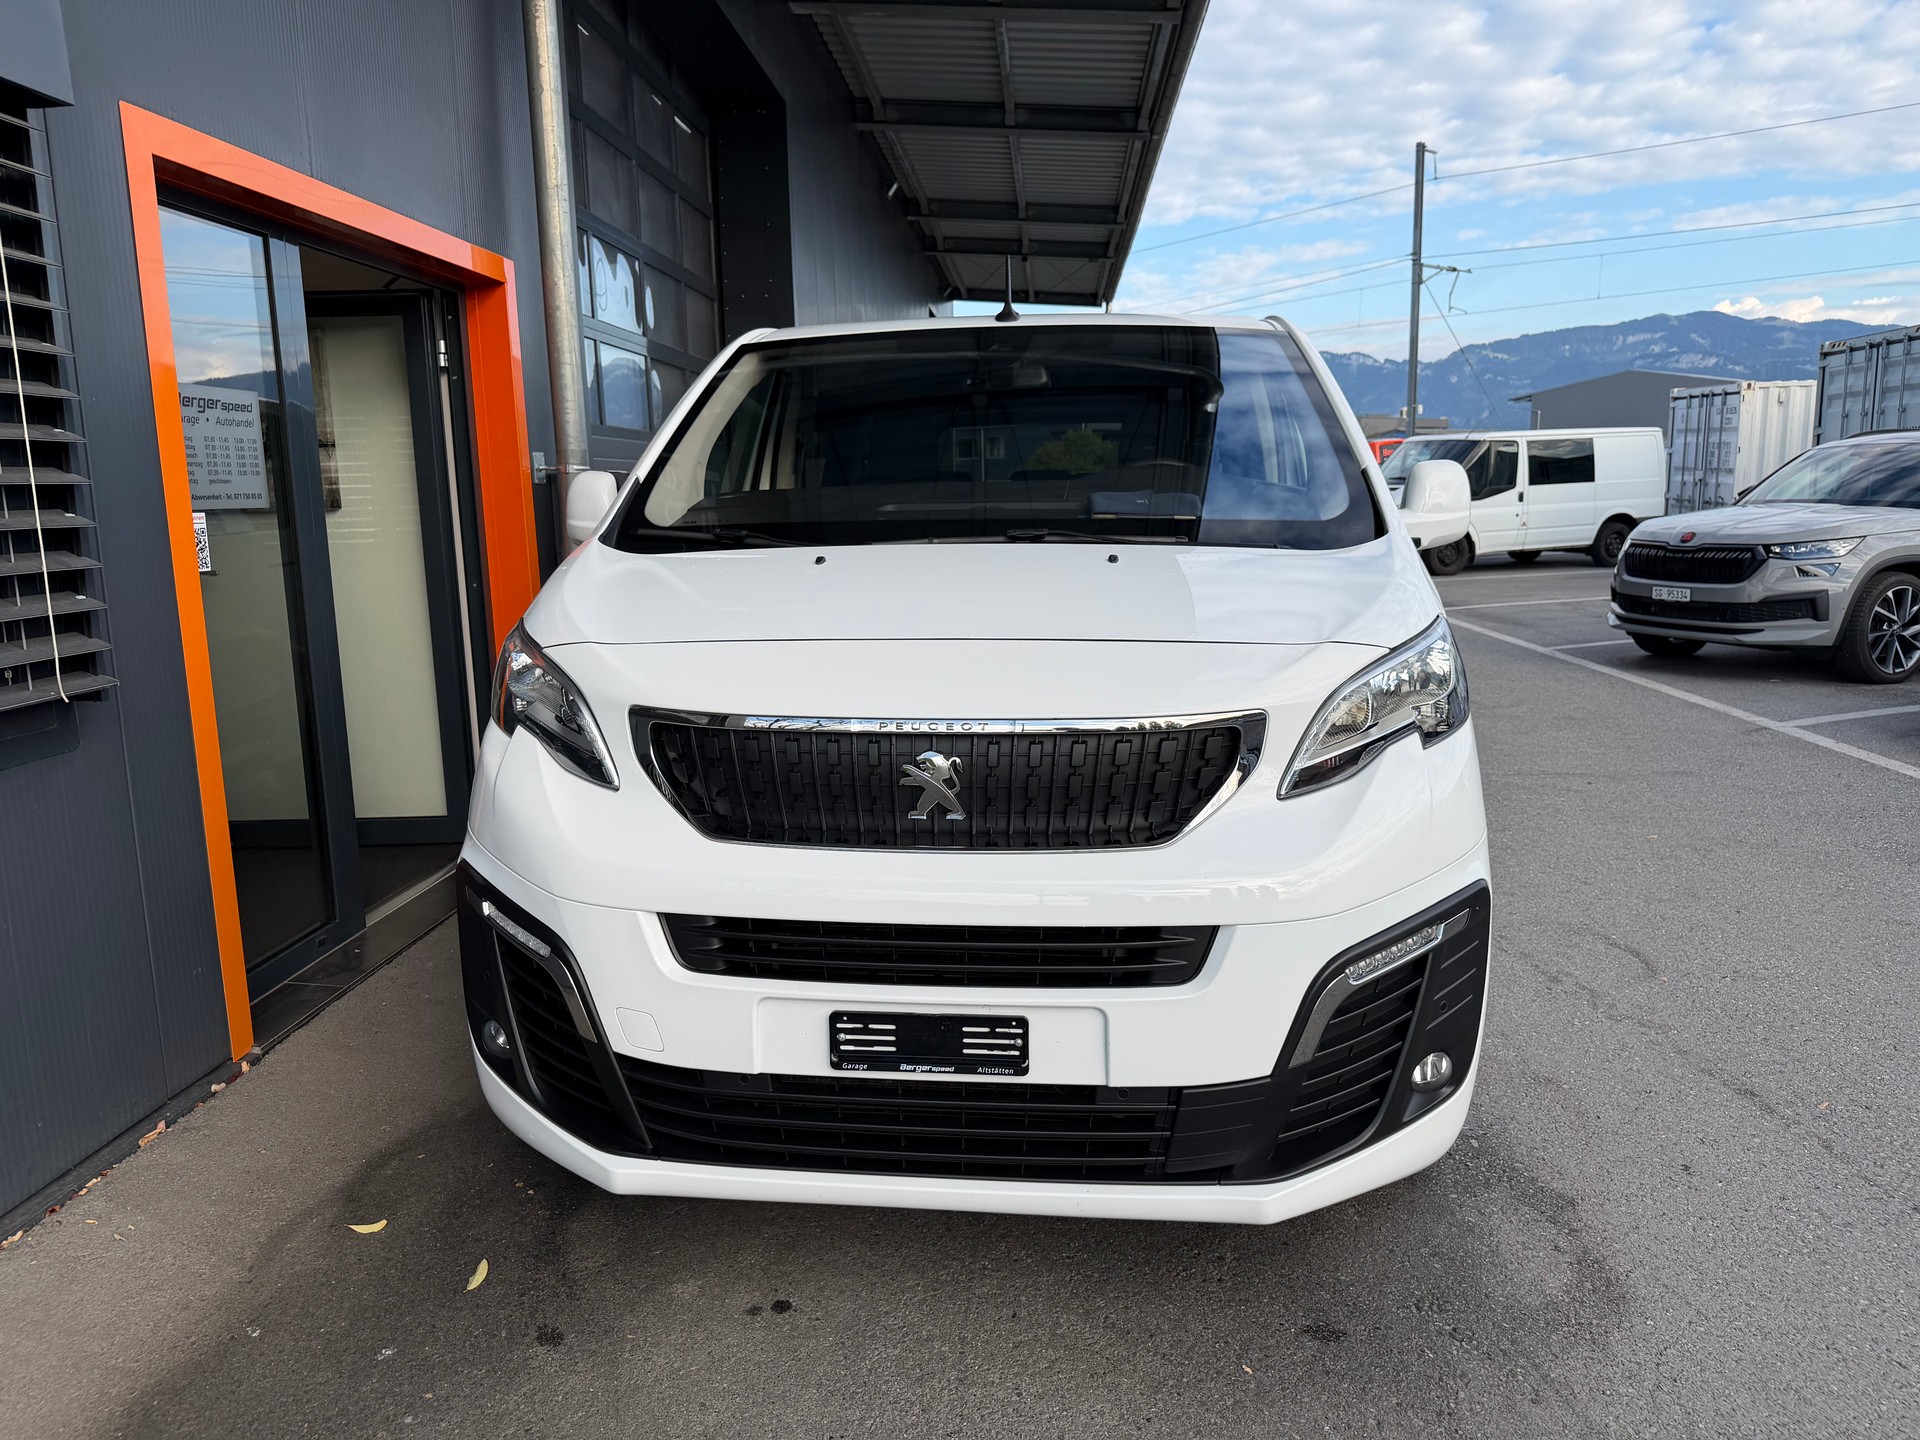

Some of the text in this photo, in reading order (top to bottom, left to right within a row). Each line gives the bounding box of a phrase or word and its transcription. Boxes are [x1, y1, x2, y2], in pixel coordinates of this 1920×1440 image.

[216, 416, 254, 428] Autohandel
[1654, 588, 1687, 599] SG 95334
[879, 722, 988, 731] PEUGEOT
[900, 1064, 954, 1073] Bergerspeed
